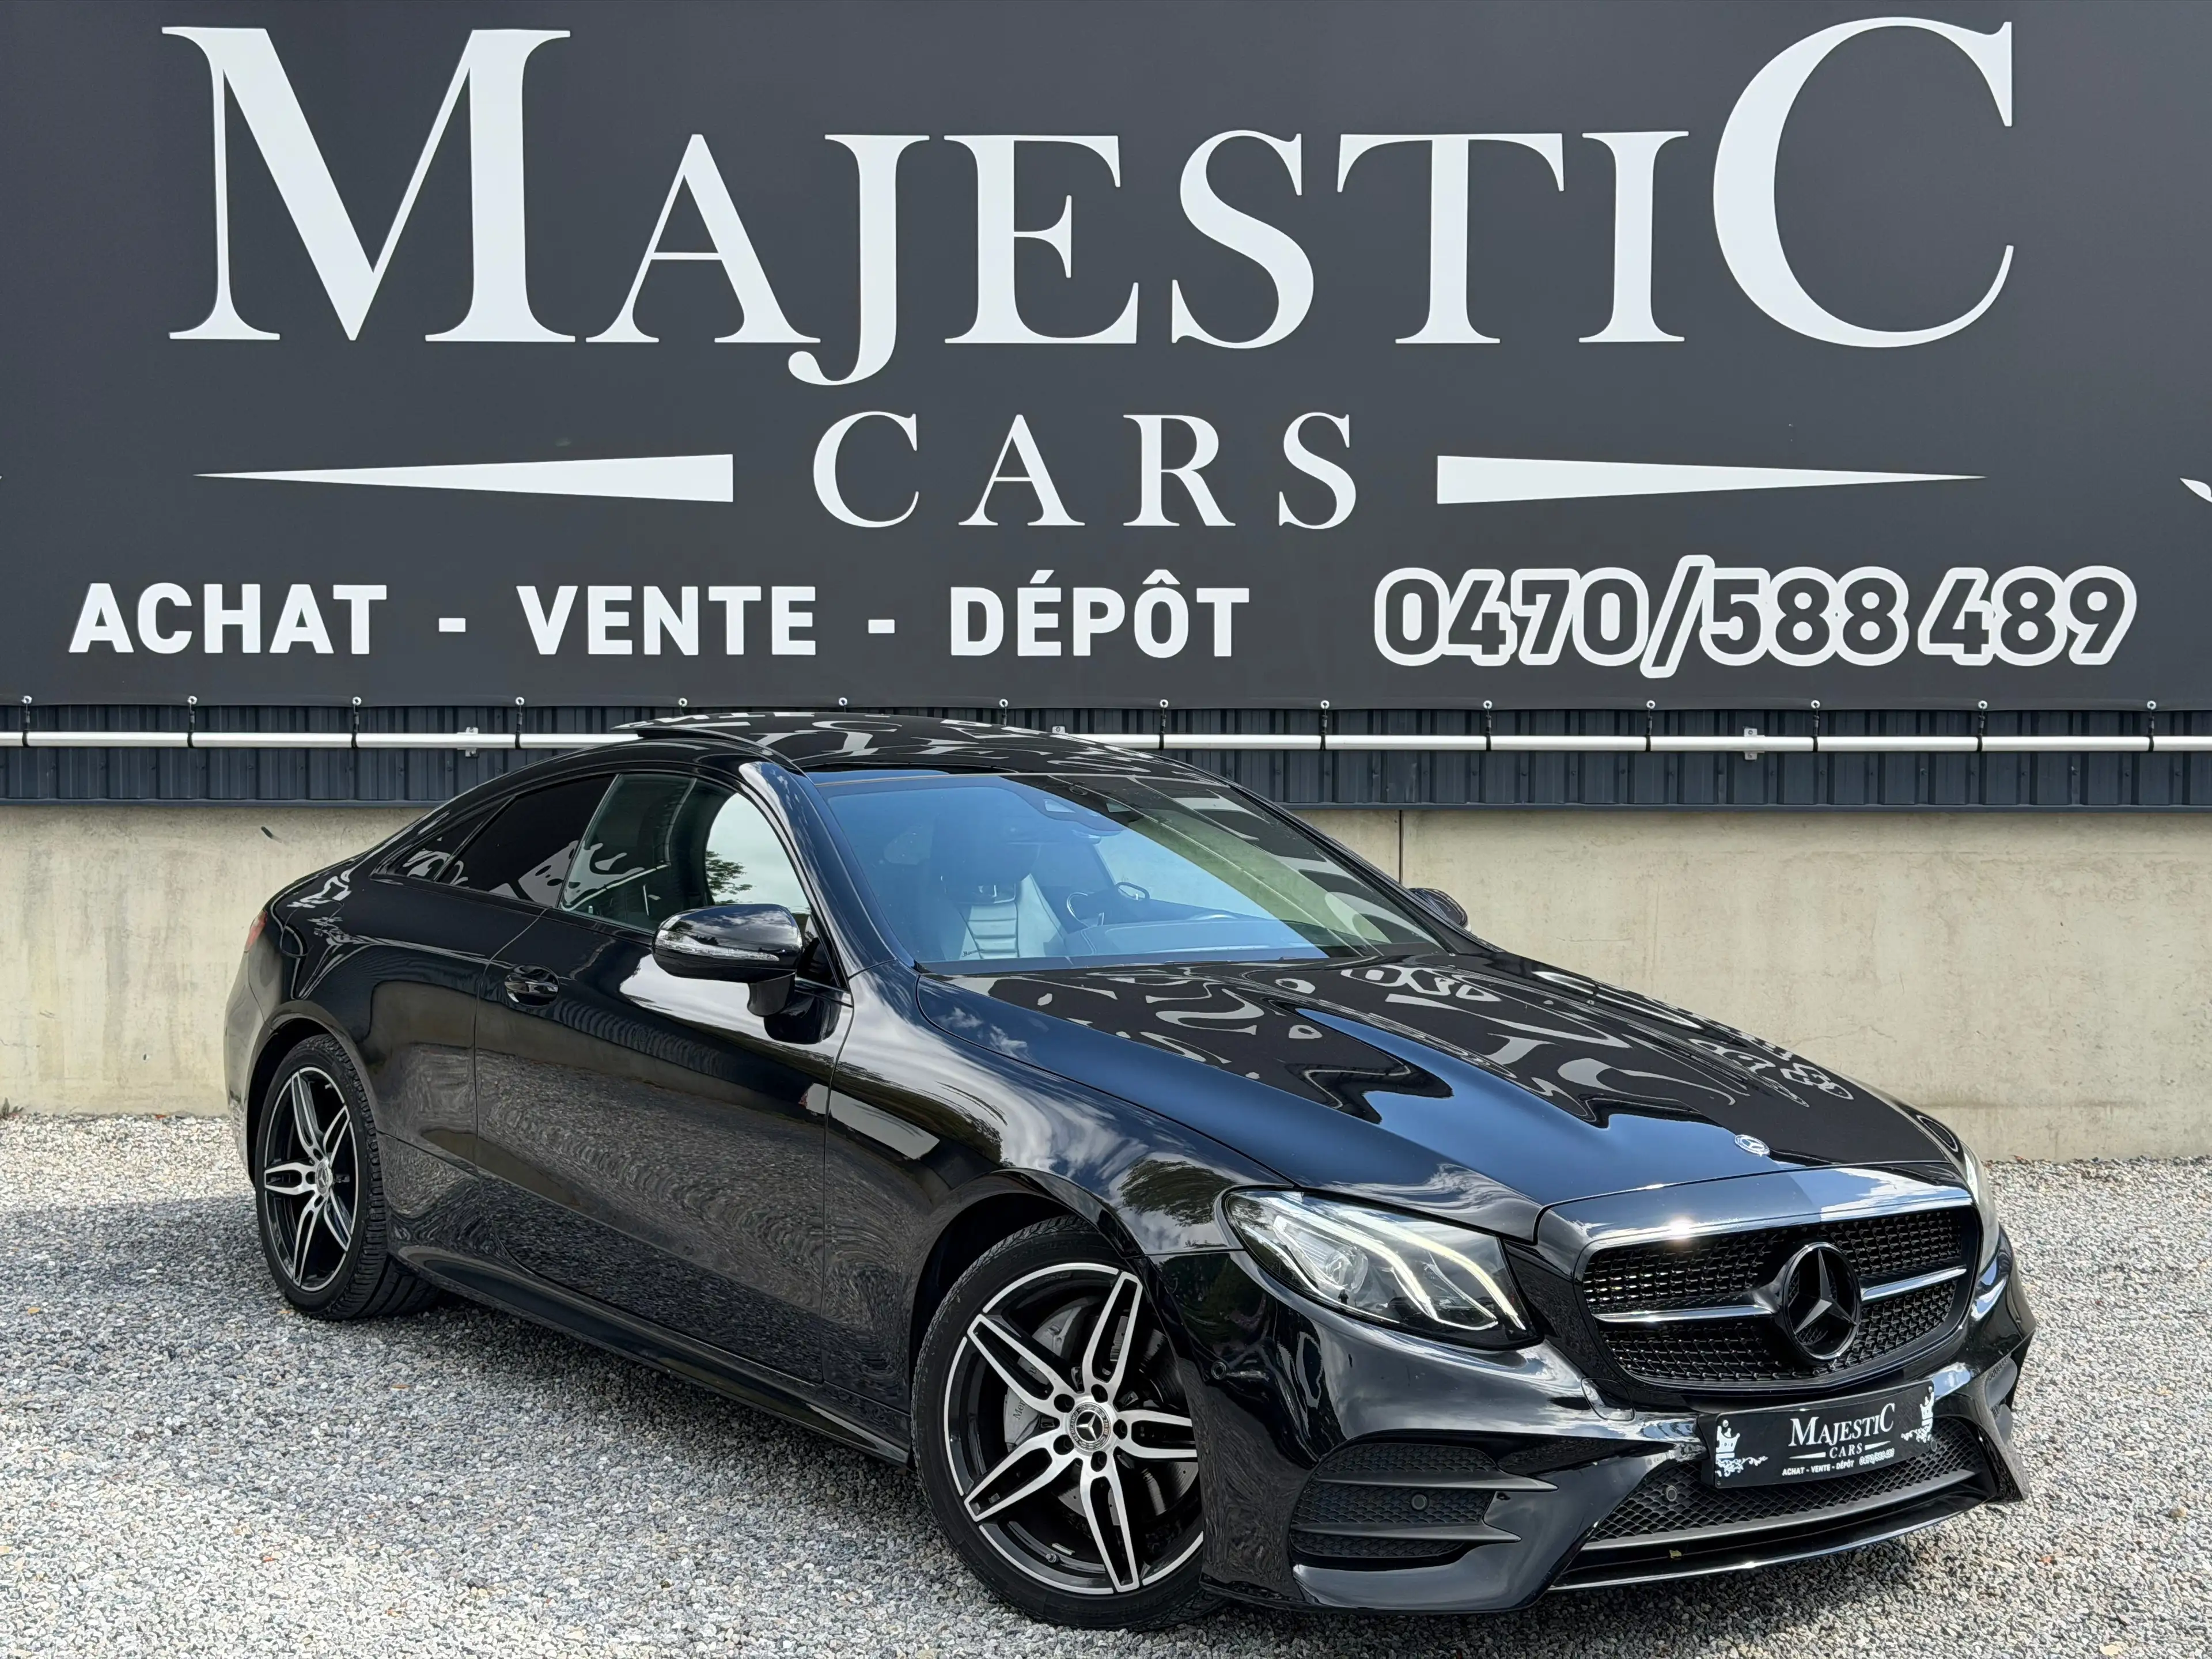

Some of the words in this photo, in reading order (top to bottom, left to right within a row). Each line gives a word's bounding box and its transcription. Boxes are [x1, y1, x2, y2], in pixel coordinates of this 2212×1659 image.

[162, 16, 2014, 386] MAJESTIC
[813, 411, 1357, 529] CARS
[69, 582, 387, 655] ACHAT
[438, 618, 466, 632] -
[516, 585, 816, 656] VENTE
[868, 619, 895, 634] -
[950, 569, 1250, 659] DÉPÔT
[1374, 554, 1910, 679] 0470/588
[1917, 565, 2138, 667] 489
[1782, 1467, 1805, 1476] ACHAT
[1810, 1464, 1831, 1474] VENTE
[1836, 1459, 1855, 1471] DÉPÔT
[1788, 1403, 1895, 1446] MAJESTIC
[1829, 1442, 1863, 1459] CARS
